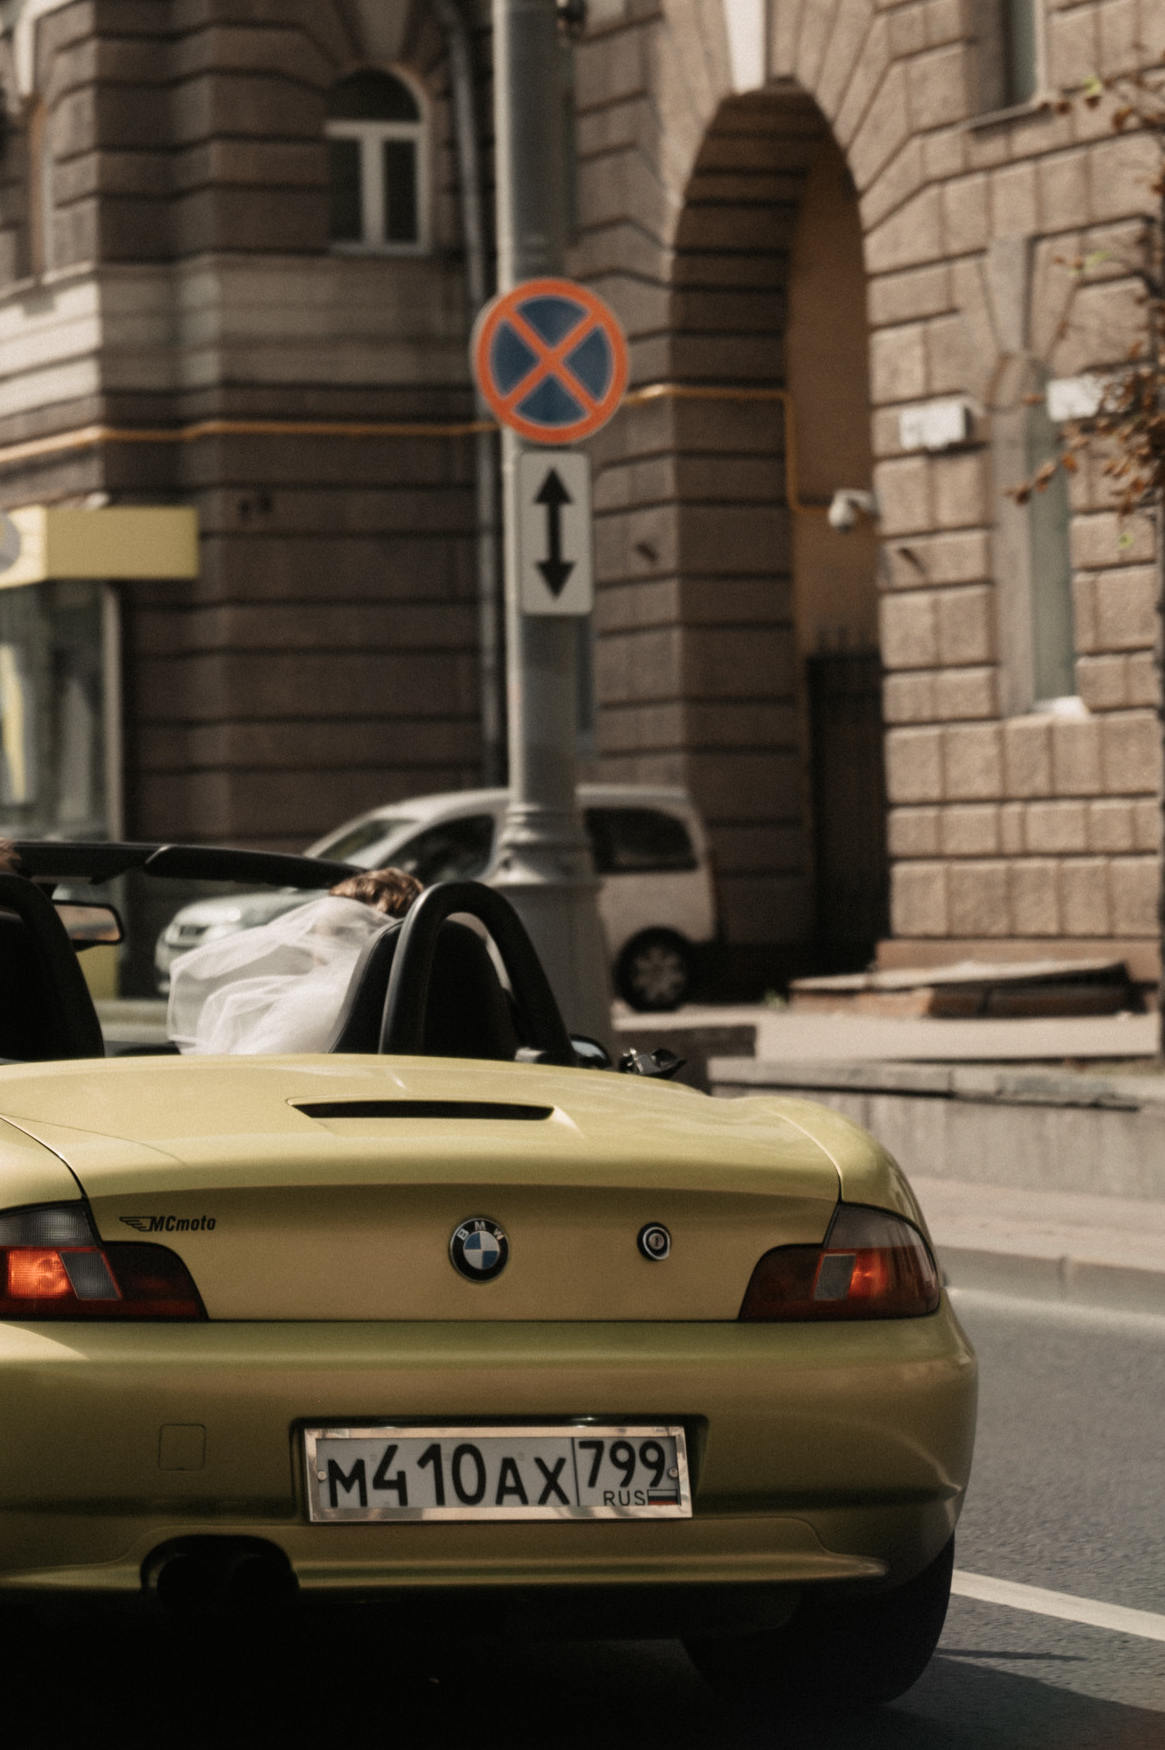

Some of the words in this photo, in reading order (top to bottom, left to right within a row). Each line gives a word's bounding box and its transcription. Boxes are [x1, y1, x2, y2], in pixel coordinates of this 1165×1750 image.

[149, 1215, 217, 1232] MCmoto
[457, 1220, 505, 1241] BMW
[578, 1440, 666, 1488] 799
[603, 1490, 646, 1506] RUS
